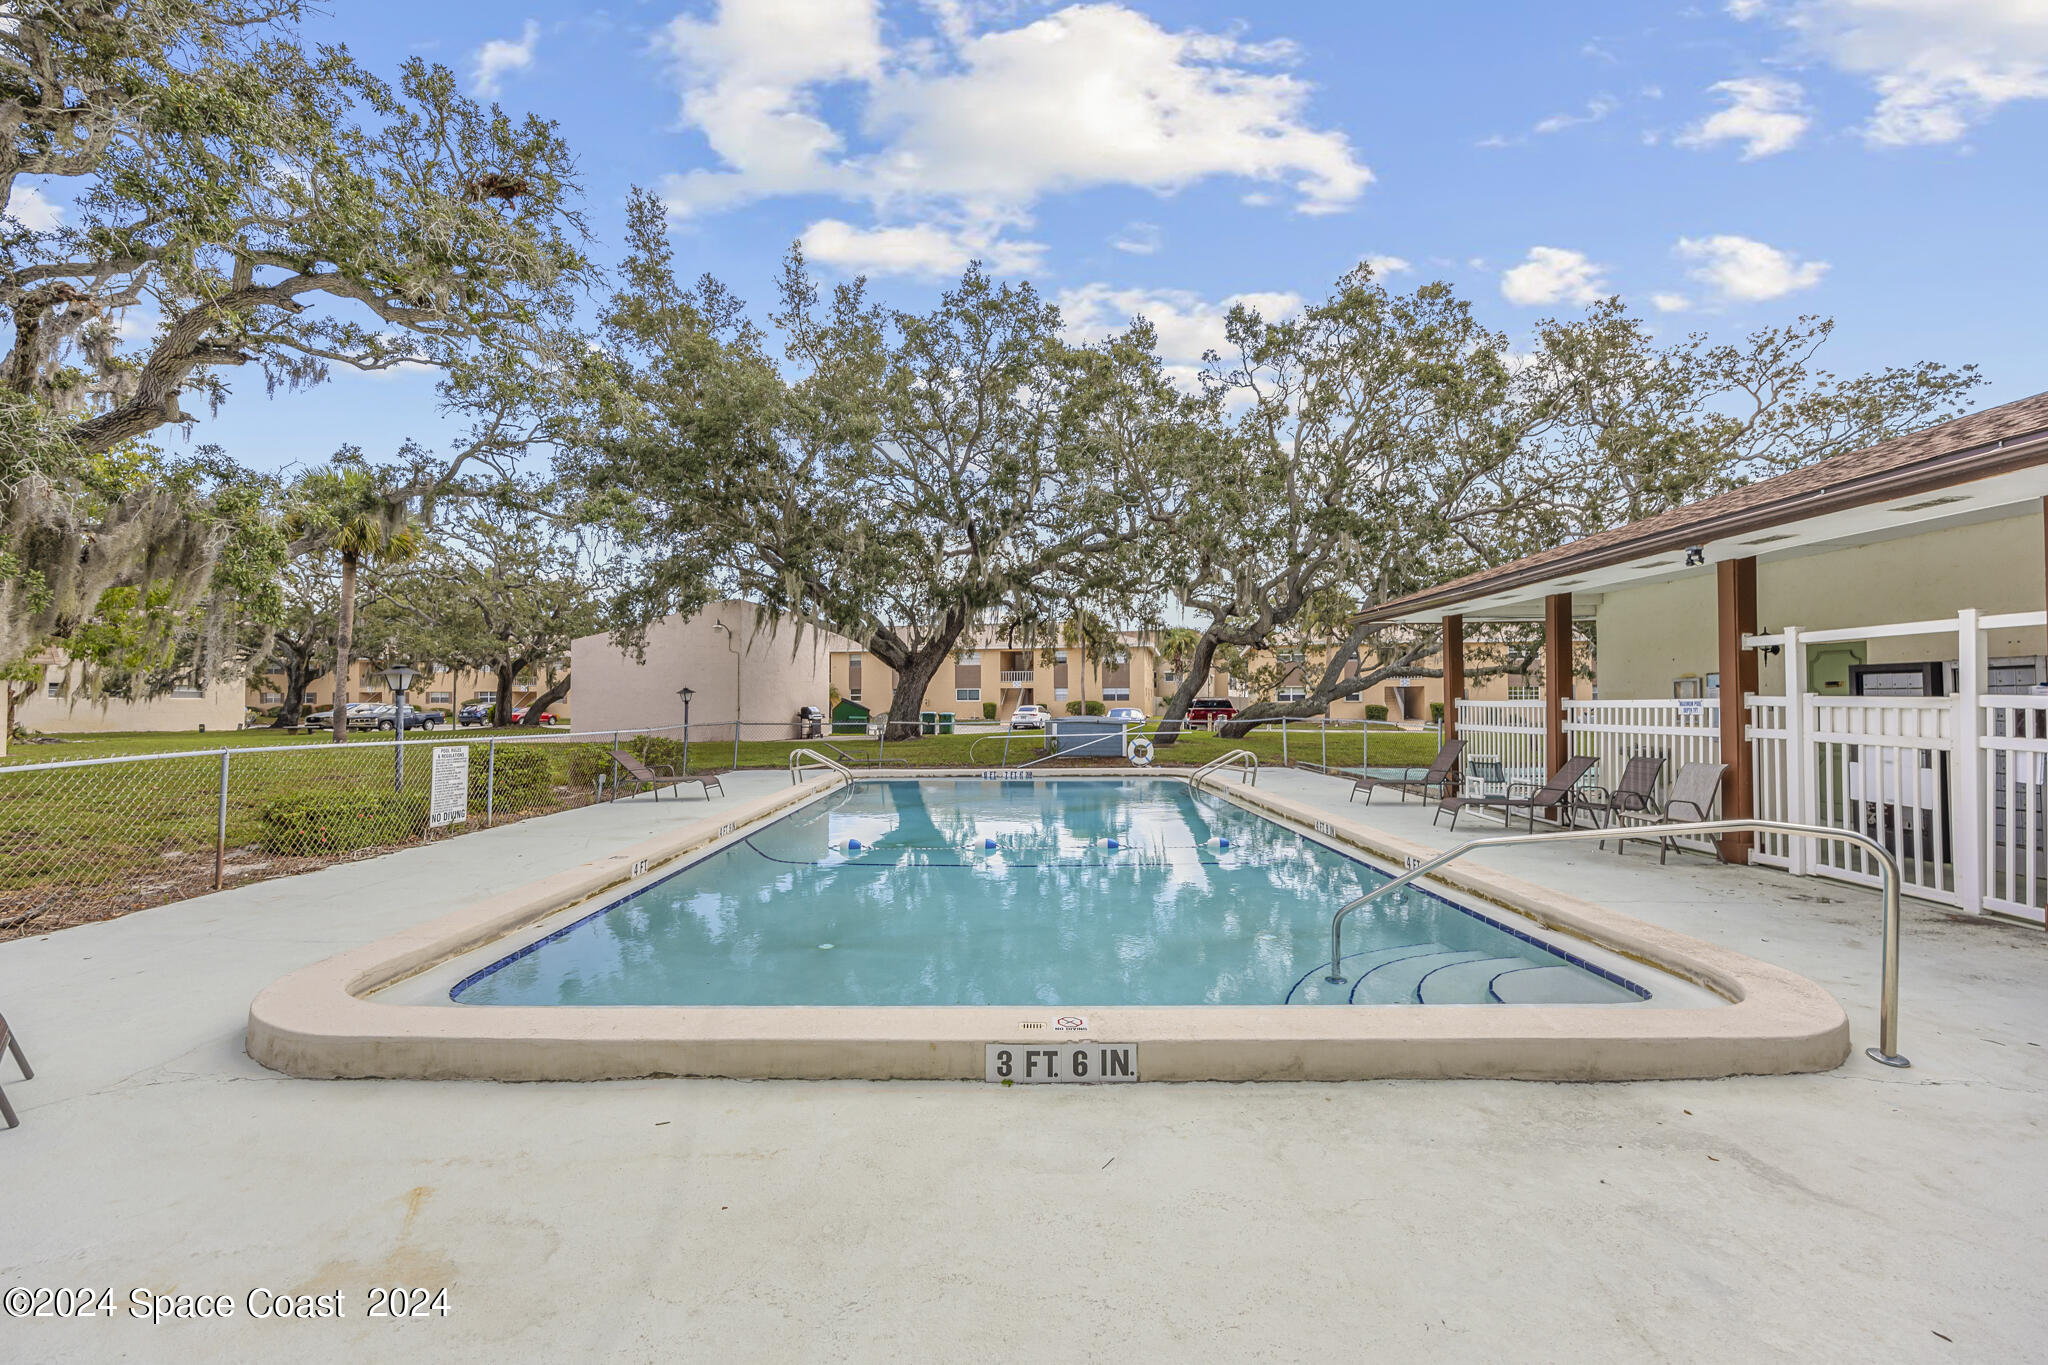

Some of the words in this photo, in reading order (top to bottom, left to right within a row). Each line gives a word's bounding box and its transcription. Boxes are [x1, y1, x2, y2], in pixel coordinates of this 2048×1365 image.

[432, 813, 441, 823] NO
[443, 809, 466, 821] DIVING
[634, 863, 638, 876] 4
[640, 859, 648, 873] FT
[1406, 857, 1411, 869] 4
[1413, 859, 1420, 869] FT
[997, 1050, 1013, 1077] 3
[1026, 1050, 1059, 1077] FT.
[1072, 1050, 1088, 1077] 6
[1101, 1049, 1135, 1077] IN.
